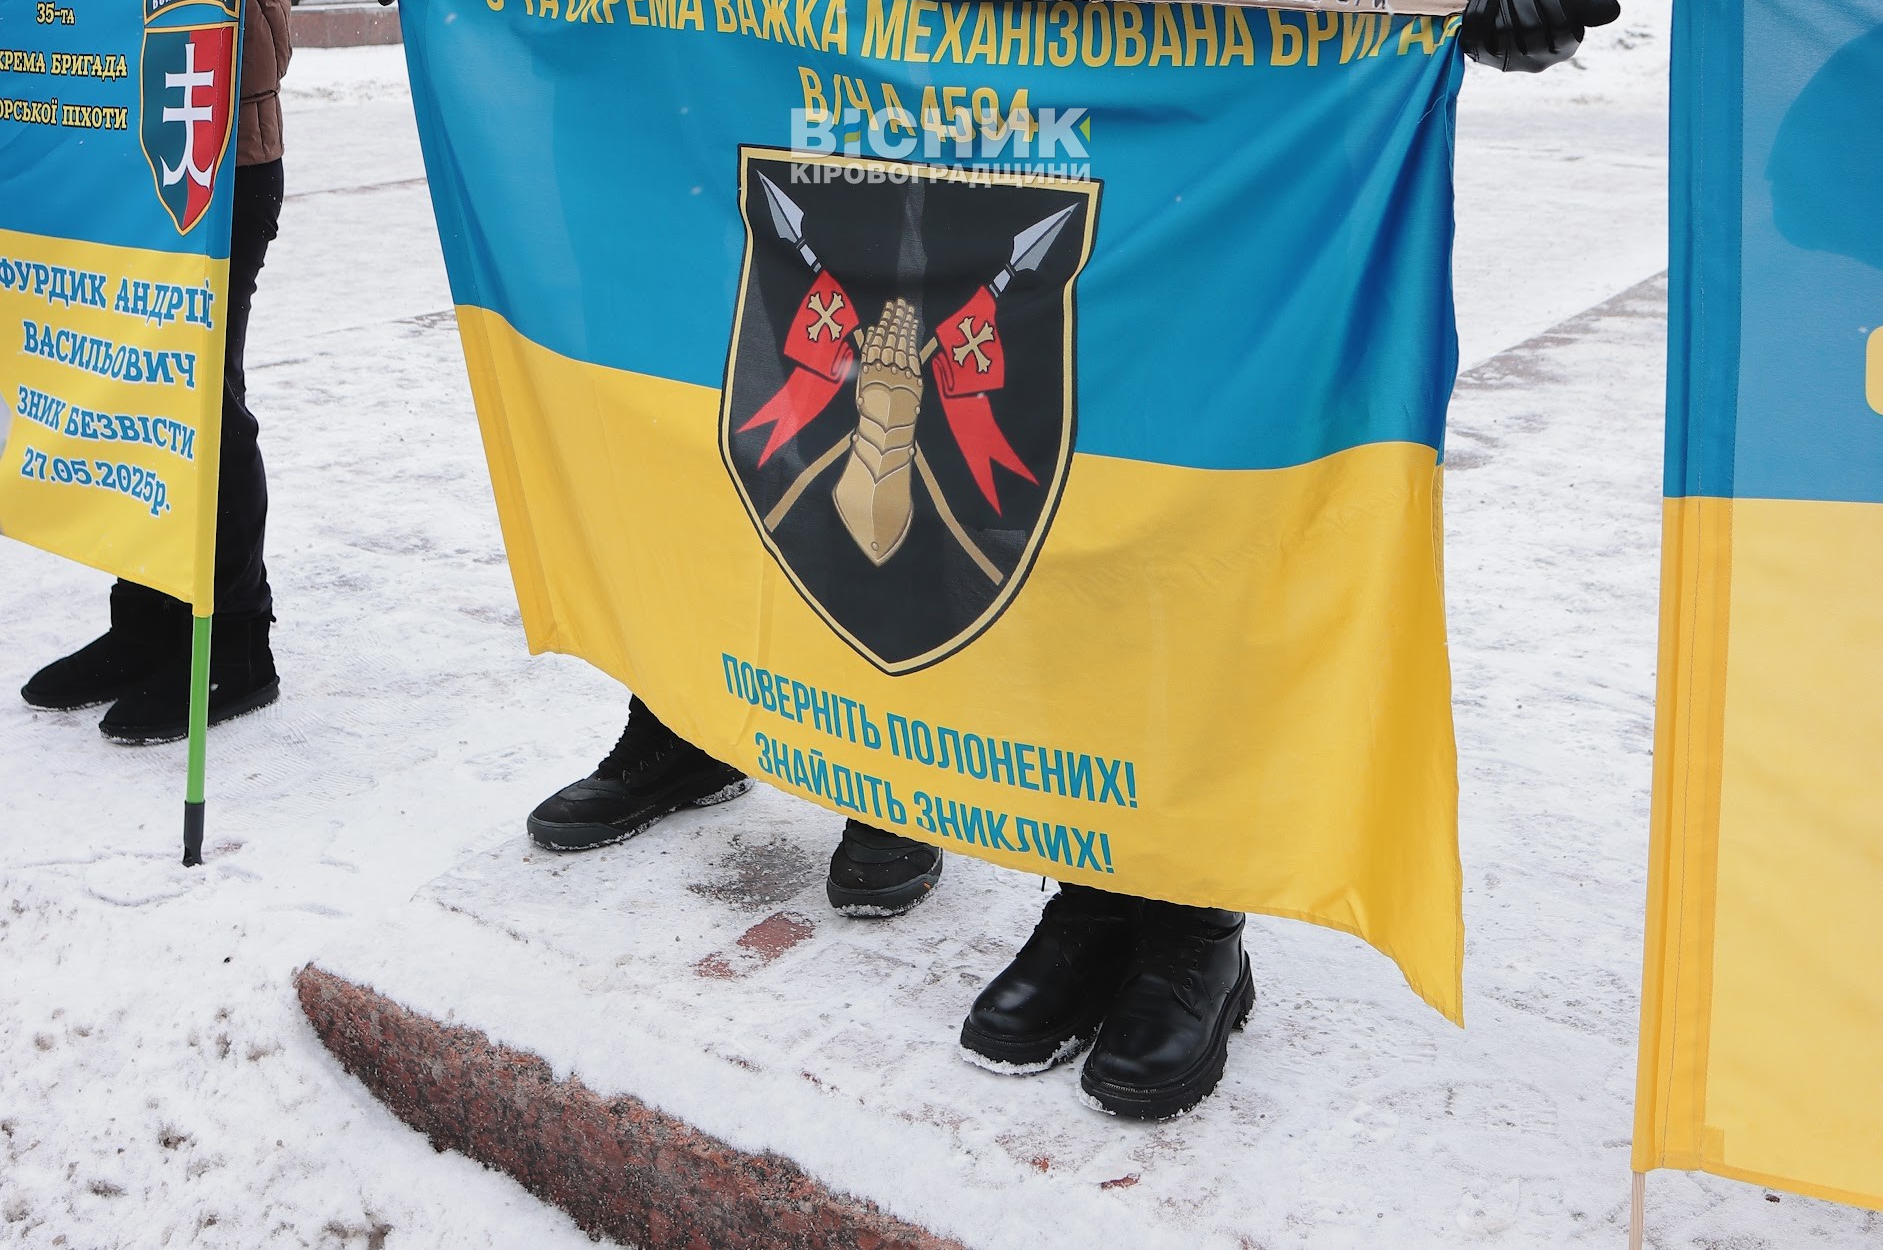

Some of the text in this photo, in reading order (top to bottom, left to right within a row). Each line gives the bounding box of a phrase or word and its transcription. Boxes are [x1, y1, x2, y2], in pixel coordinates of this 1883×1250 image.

[50, 53, 128, 82] БРИГАДА
[798, 66, 880, 132] В/Ч
[62, 104, 128, 130] ПІХОТИ
[0, 257, 107, 309] ФУРДИК
[23, 320, 196, 390] ВАСИЛЬОВИЧ
[17, 384, 196, 461] ЗНИК БЕЗВІСТИ
[21, 445, 171, 516] 27.05.2025р.
[721, 652, 1139, 809] ПОВЕРНІТЬ ПОЛОНЕНИХ!
[754, 731, 1115, 874] ЗНАЙДІТЬ ЗНИКЛИХ!
